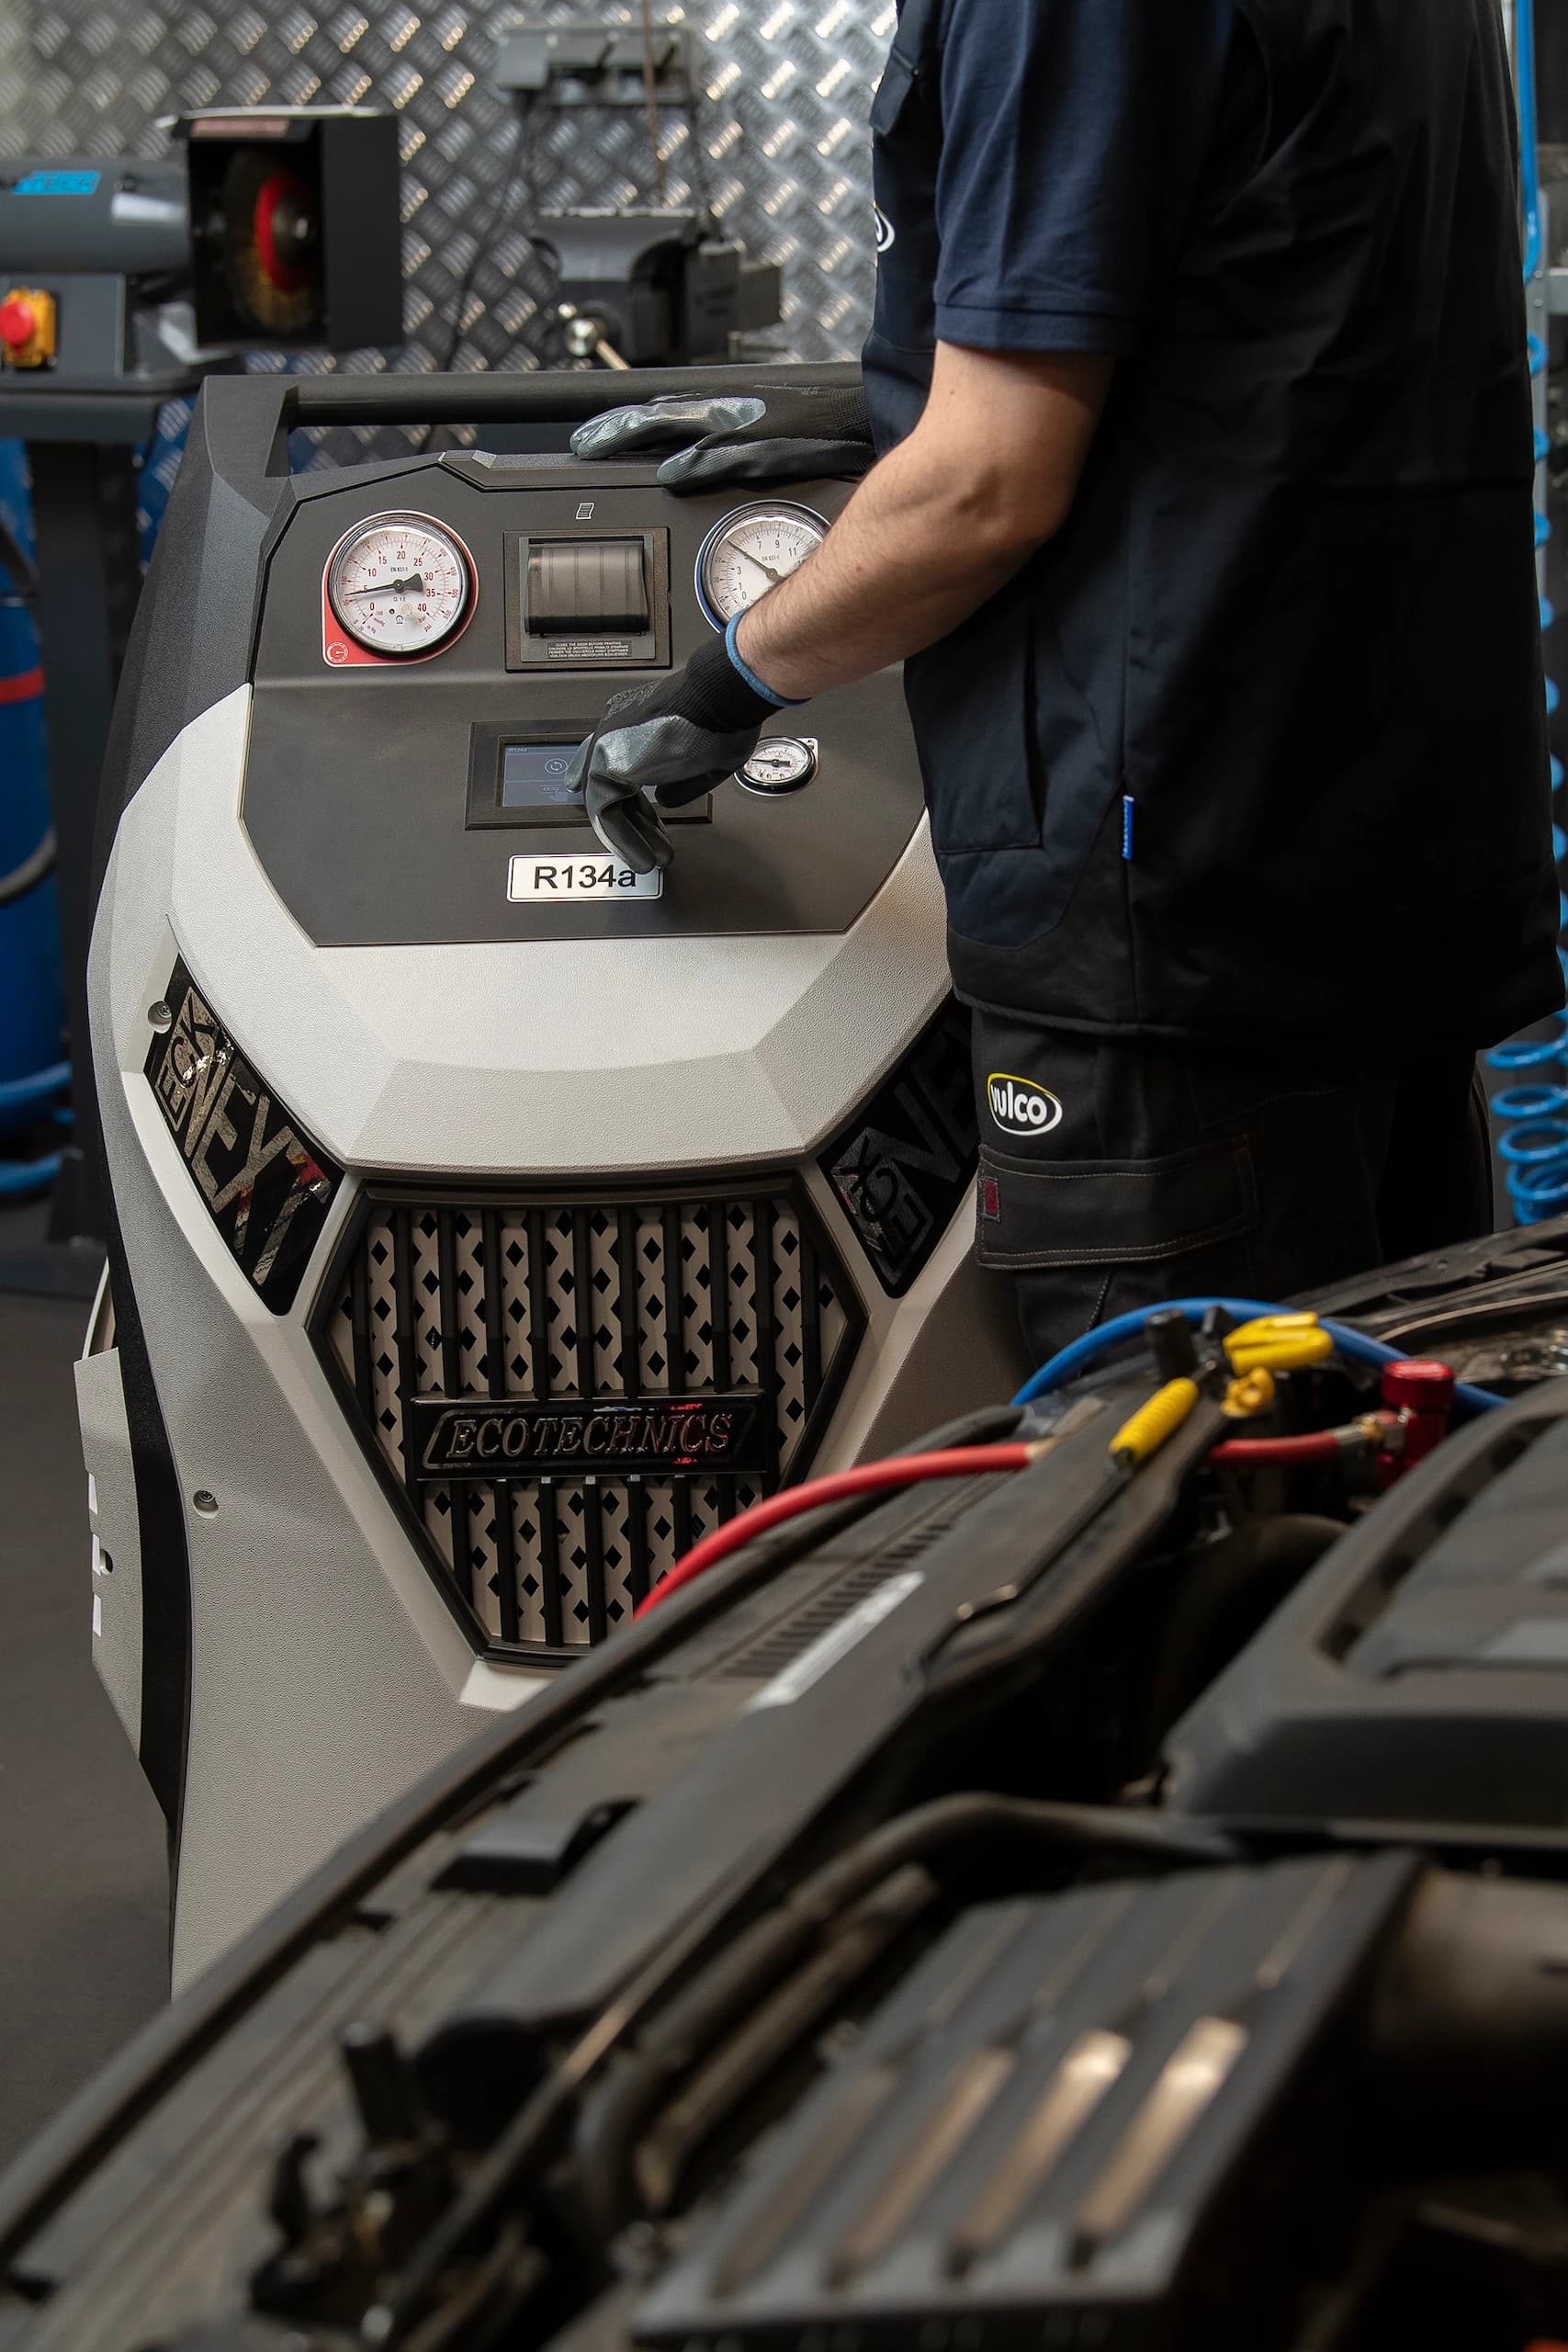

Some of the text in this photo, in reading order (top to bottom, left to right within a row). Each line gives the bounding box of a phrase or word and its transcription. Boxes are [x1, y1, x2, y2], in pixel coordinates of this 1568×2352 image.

[756, 541, 762, 549] 7
[774, 540, 781, 548] 9
[396, 550, 406, 560] 20
[788, 547, 797, 557] 11
[378, 556, 388, 565] 15
[413, 557, 423, 567] 25
[367, 568, 377, 577] 10
[737, 567, 742, 575] 3
[423, 572, 434, 581] 30
[426, 589, 436, 597] 35
[741, 592, 747, 600] 0
[369, 603, 375, 611] 0
[417, 603, 427, 612] 40
[534, 865, 636, 889] R134a
[446, 1413, 733, 1458] ECOTECHNICS
